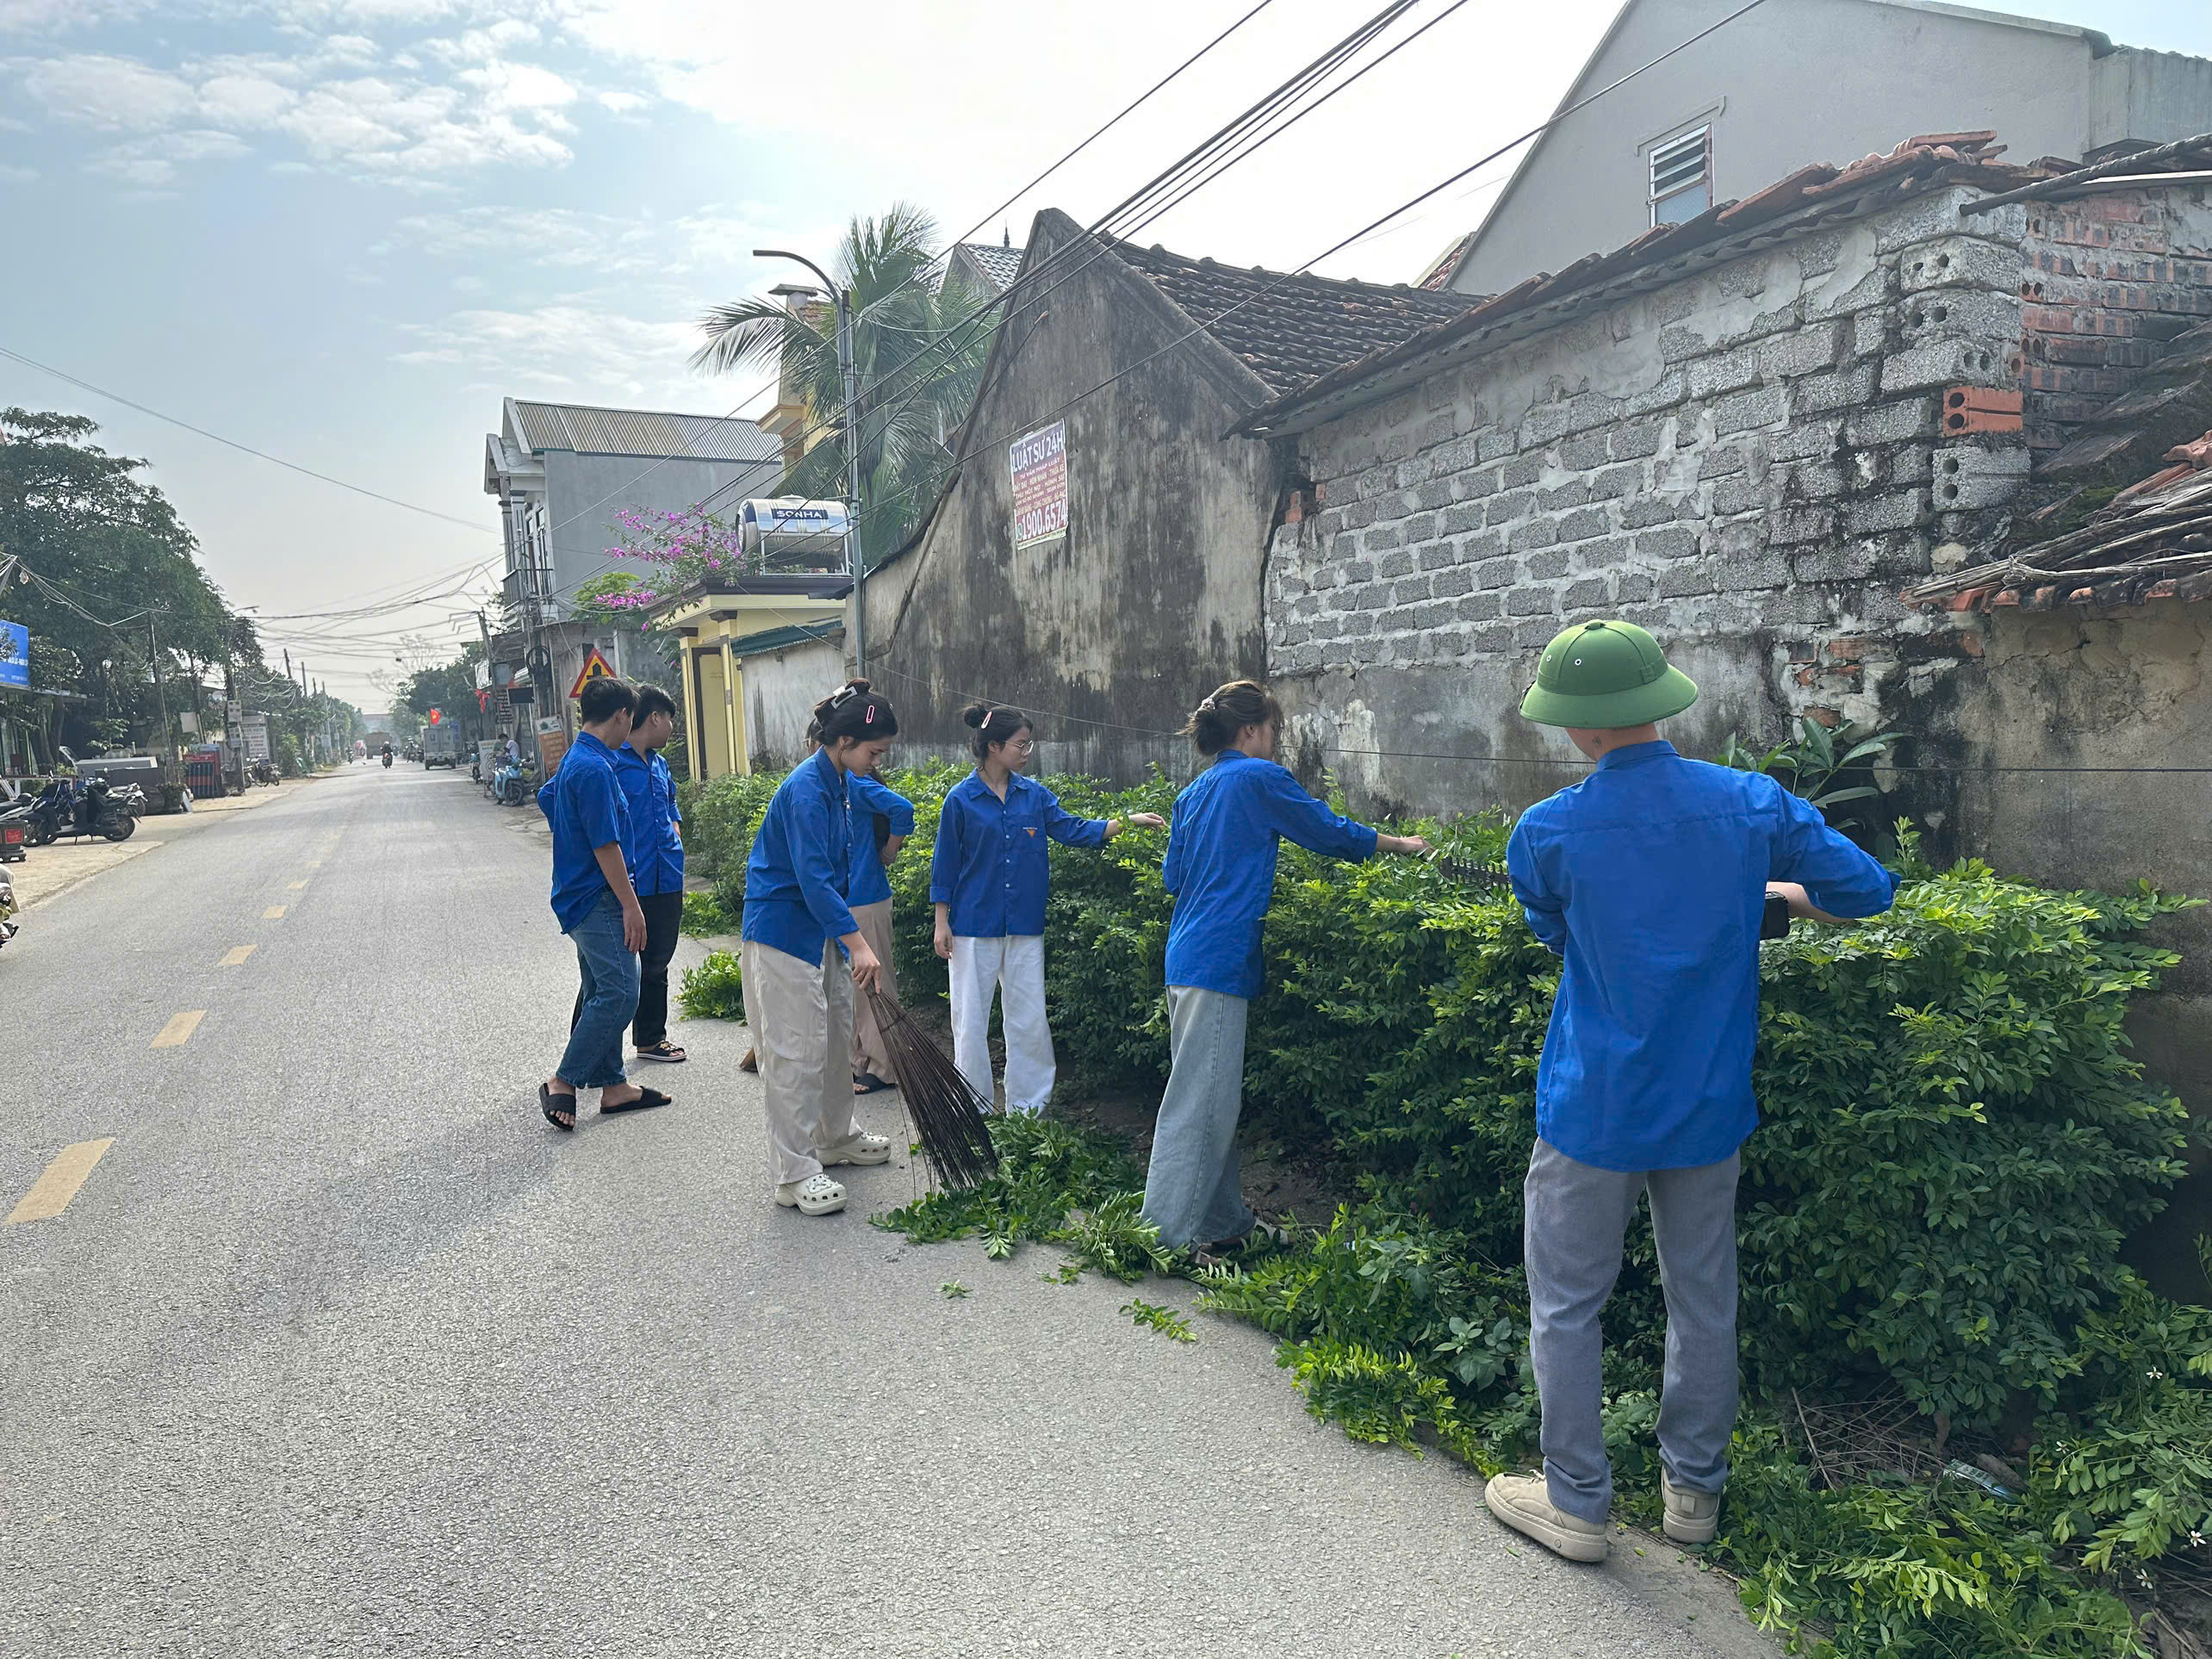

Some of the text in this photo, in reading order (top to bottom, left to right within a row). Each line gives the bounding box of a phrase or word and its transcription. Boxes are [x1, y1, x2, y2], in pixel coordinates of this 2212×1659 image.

[1012, 431, 1064, 472] LUẬT SƯ 24H
[776, 510, 822, 519] SONHA
[1022, 498, 1067, 540] 1900.6574
